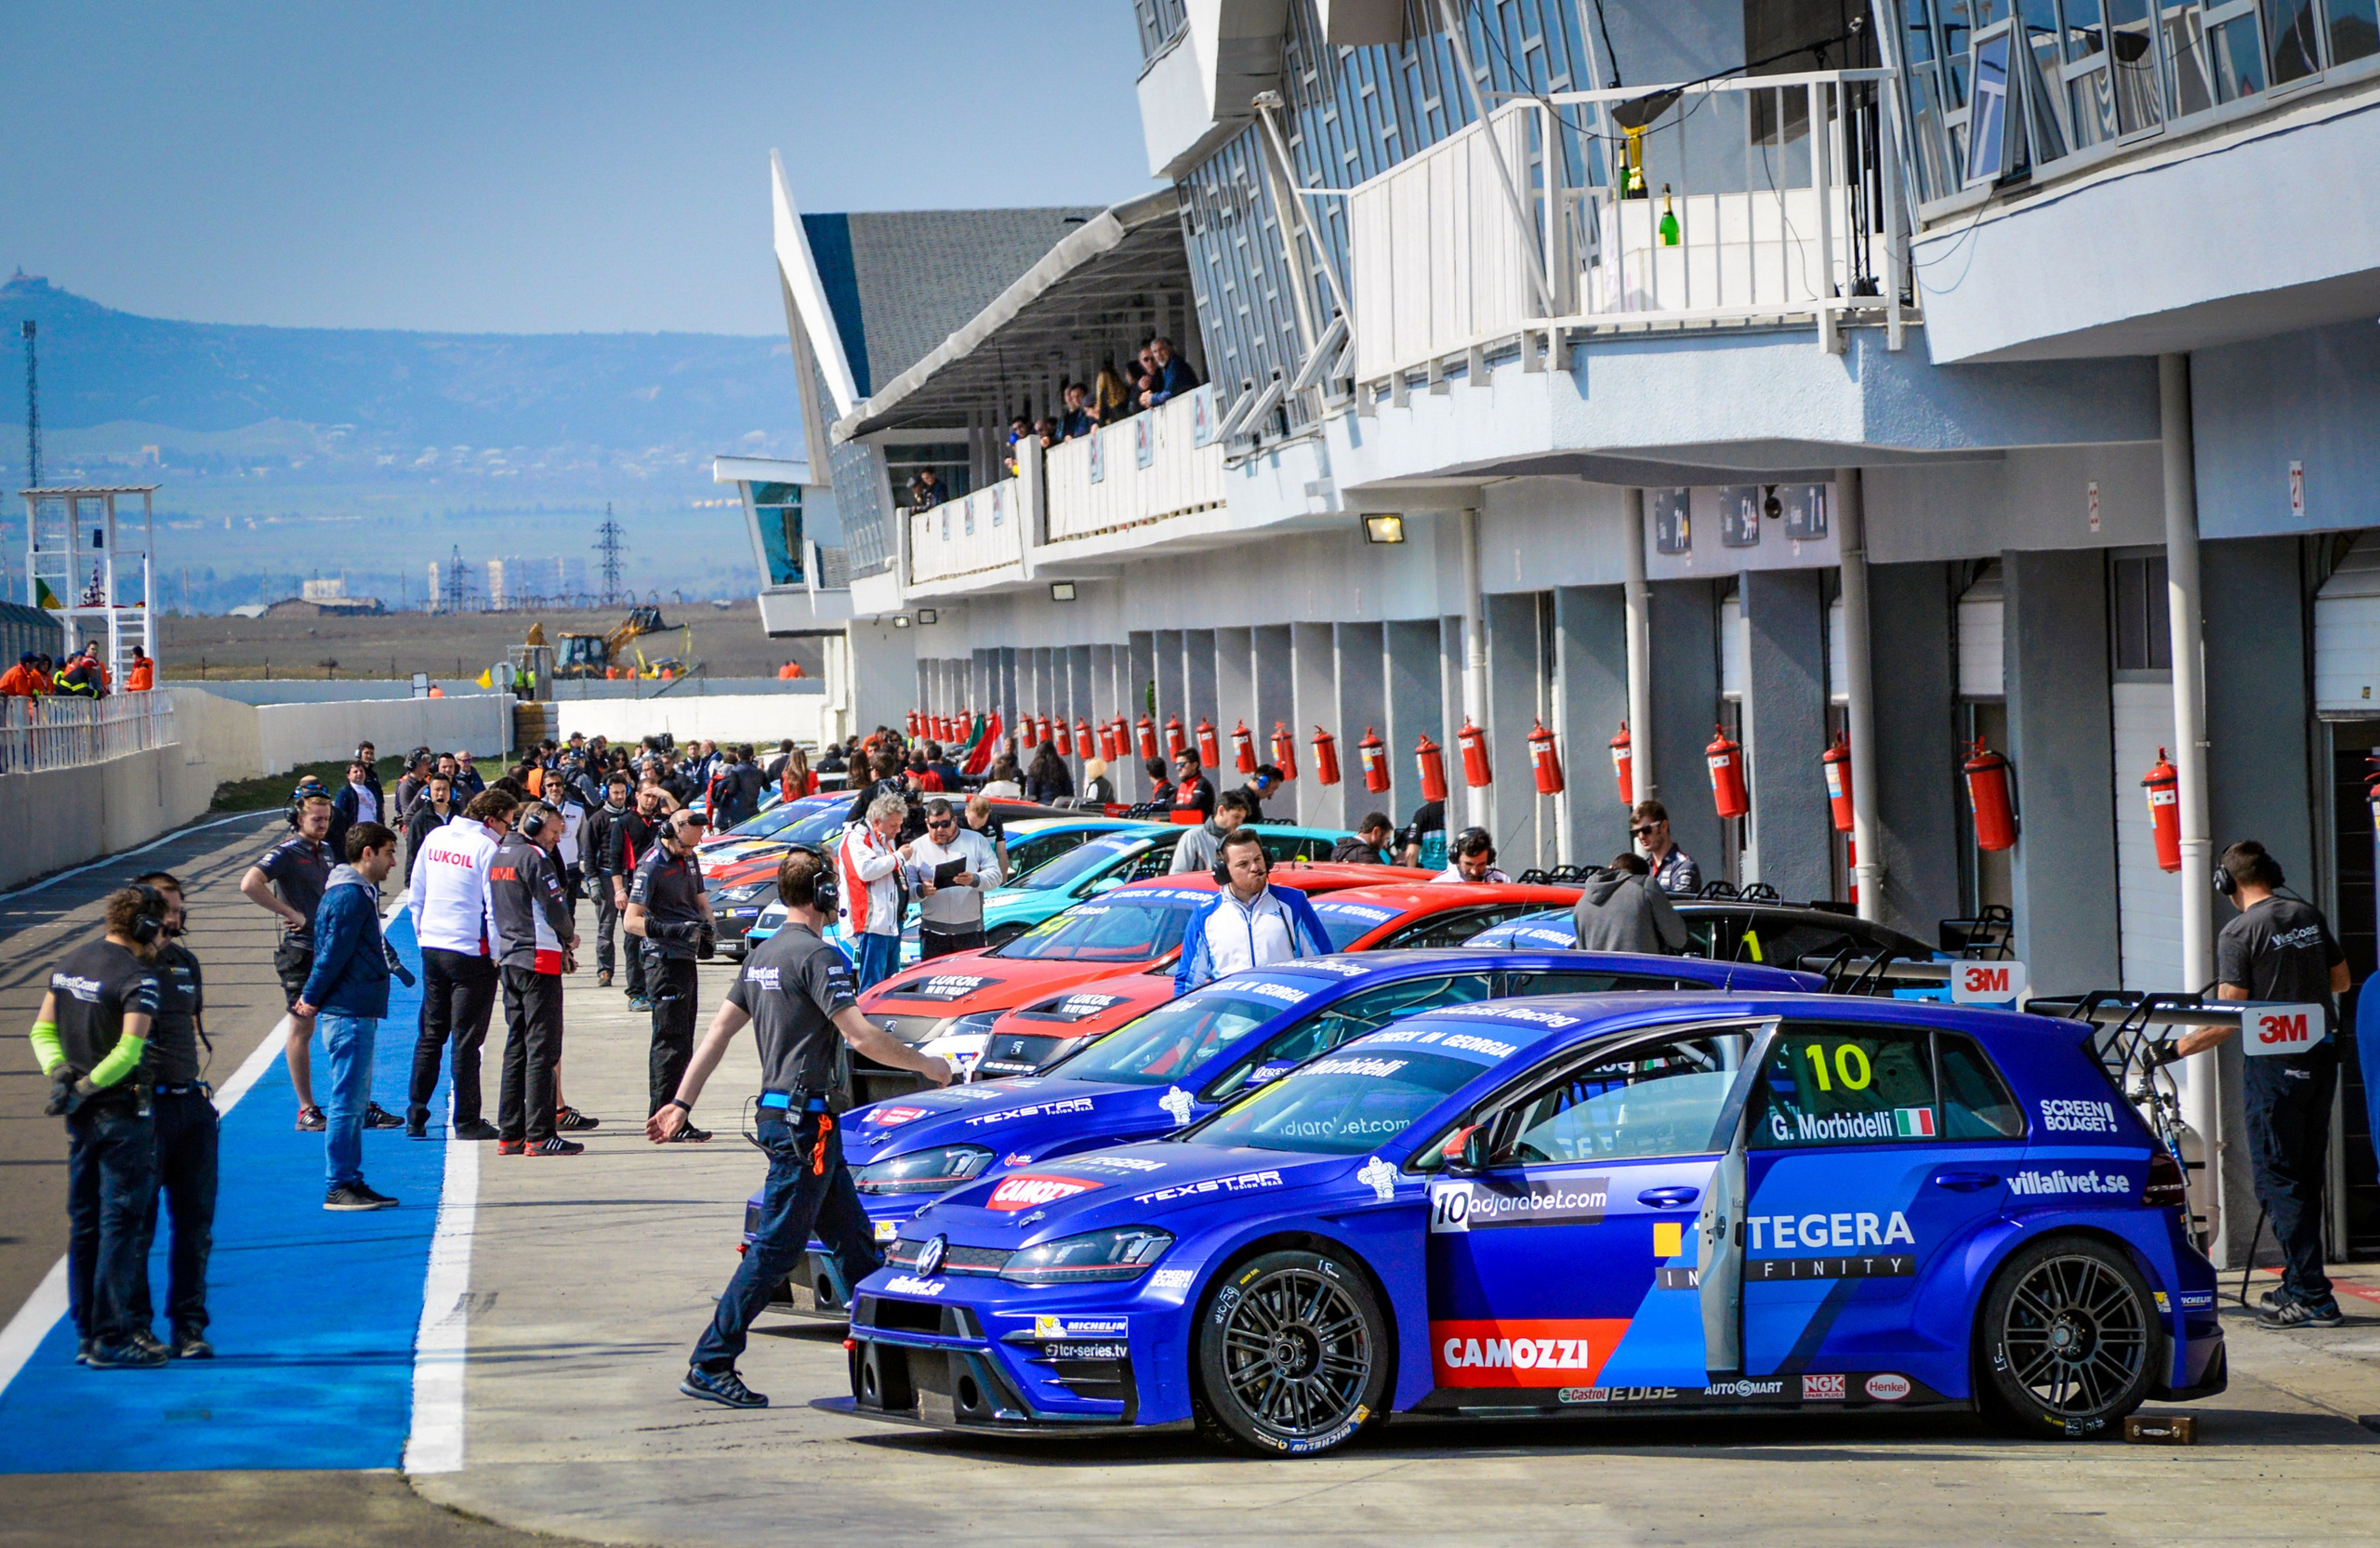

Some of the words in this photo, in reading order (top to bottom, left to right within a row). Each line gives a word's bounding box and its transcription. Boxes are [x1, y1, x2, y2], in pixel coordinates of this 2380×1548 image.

[429, 848, 473, 868] LUKOIL
[1113, 890, 1157, 899] CHECK
[1155, 890, 1172, 898] IN
[1338, 906, 1392, 921] GEORGIA
[1527, 929, 1577, 946] GEORGIA
[1741, 931, 1763, 961] 1
[52, 972, 102, 992] WestCoast
[925, 986, 935, 994] IN
[934, 986, 949, 994] MY
[928, 975, 984, 987] LUKOIL
[1964, 968, 2008, 992] 3M
[1066, 994, 1117, 1006] LUKOIL
[1238, 981, 1259, 992] IN
[1253, 983, 1310, 1004] GEORGIA
[1499, 1007, 1580, 1027] Racing
[2258, 1013, 2307, 1044] 3M
[1368, 1030, 1421, 1043] CHECK
[1417, 1031, 1443, 1044] IN
[1440, 1034, 1518, 1059] GEORGIA
[1805, 1043, 1871, 1091] 10
[965, 1098, 1093, 1126] TEXSTAR
[1074, 1105, 1095, 1113] WEAR
[2040, 1099, 2106, 1118] SCREEN
[1771, 1114, 1795, 1141] G.
[1797, 1111, 1894, 1140] Morbidelli
[1133, 1171, 1281, 1204] TEXSTAR
[1227, 1182, 1259, 1192] FUSION
[1260, 1178, 1284, 1187] WEAR
[2006, 1170, 2131, 1195] villalivet.se
[1436, 1191, 1470, 1225] 10
[1469, 1189, 1607, 1217] adjarabet.com
[1747, 1211, 1915, 1250] TEGERA
[1067, 1321, 1127, 1331] MICHELIN
[1059, 1343, 1129, 1358] tcr-series.tv
[1443, 1337, 1589, 1369] CAMOZZI
[1570, 1387, 1607, 1401] Castrol
[1609, 1386, 1678, 1402] EDGE
[1804, 1376, 1845, 1393] NGK
[1870, 1381, 1908, 1393] Henkel
[1291, 1423, 1353, 1452] MICHELIN
